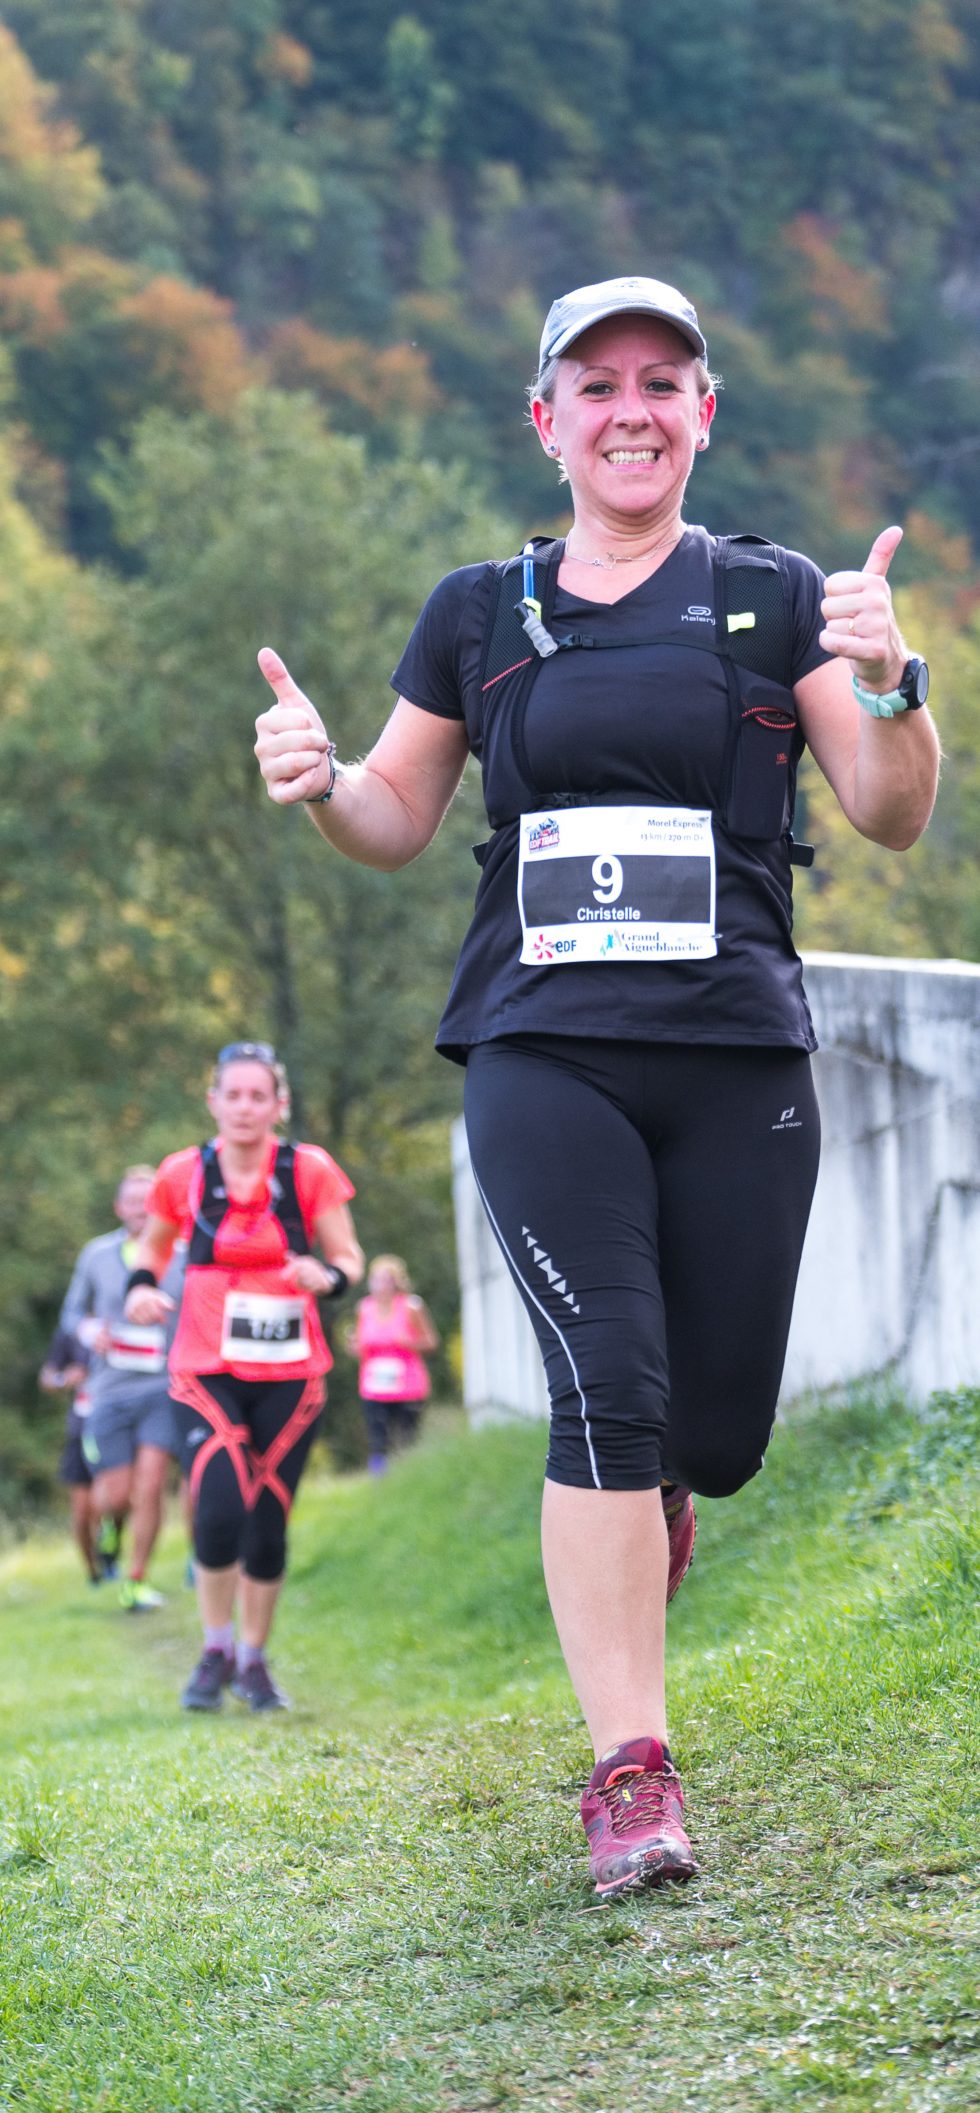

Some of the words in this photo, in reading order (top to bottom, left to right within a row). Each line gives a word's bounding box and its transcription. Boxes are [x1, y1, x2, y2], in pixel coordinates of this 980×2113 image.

[680, 614, 716, 626] Kalenj
[647, 819, 671, 827] Morel
[672, 819, 703, 829] Express
[668, 834, 682, 842] 270
[591, 854, 624, 904] 9
[576, 906, 641, 921] Christelle
[621, 932, 660, 942] Grand
[623, 942, 703, 953] Aigueblanche
